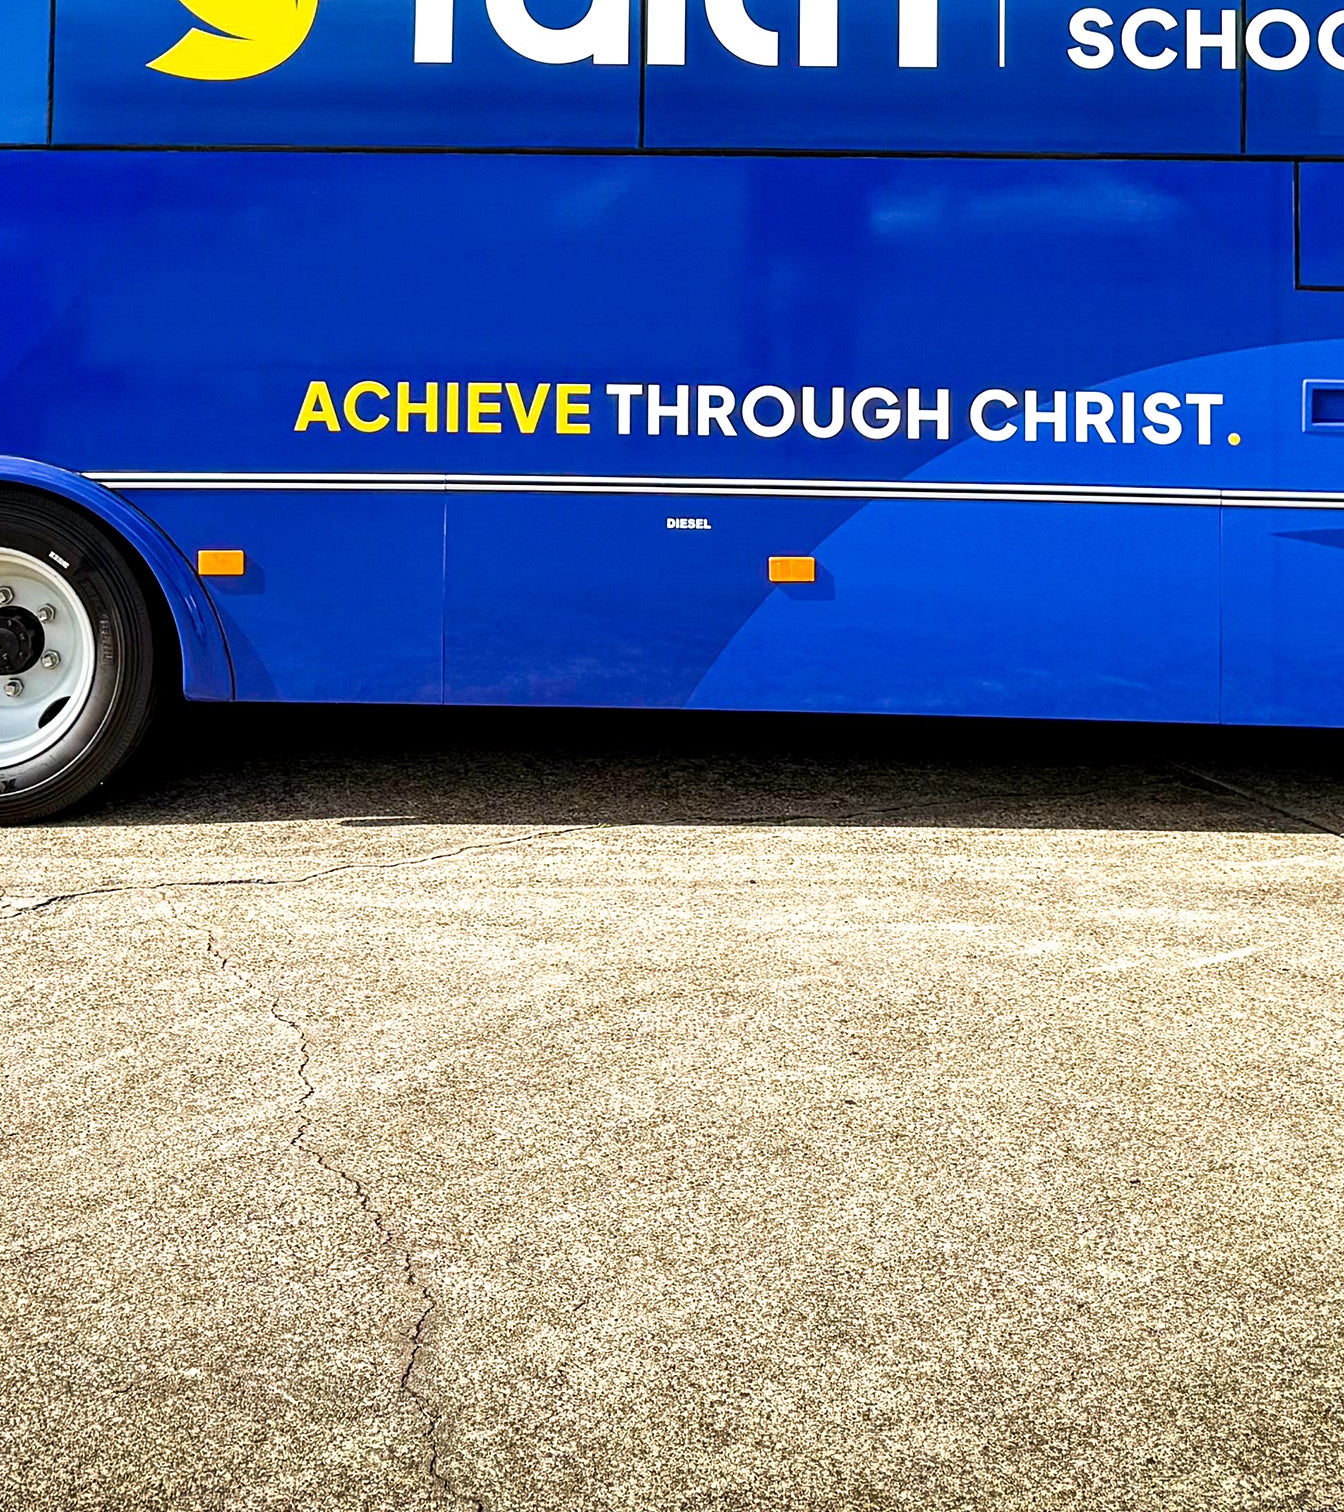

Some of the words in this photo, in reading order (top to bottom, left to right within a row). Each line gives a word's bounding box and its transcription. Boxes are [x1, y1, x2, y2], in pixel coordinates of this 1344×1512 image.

[296, 381, 591, 434] ACHIEVE
[606, 383, 949, 440] THROUGH
[969, 388, 1241, 446] CHRIST.
[666, 518, 712, 530] DIESEL
